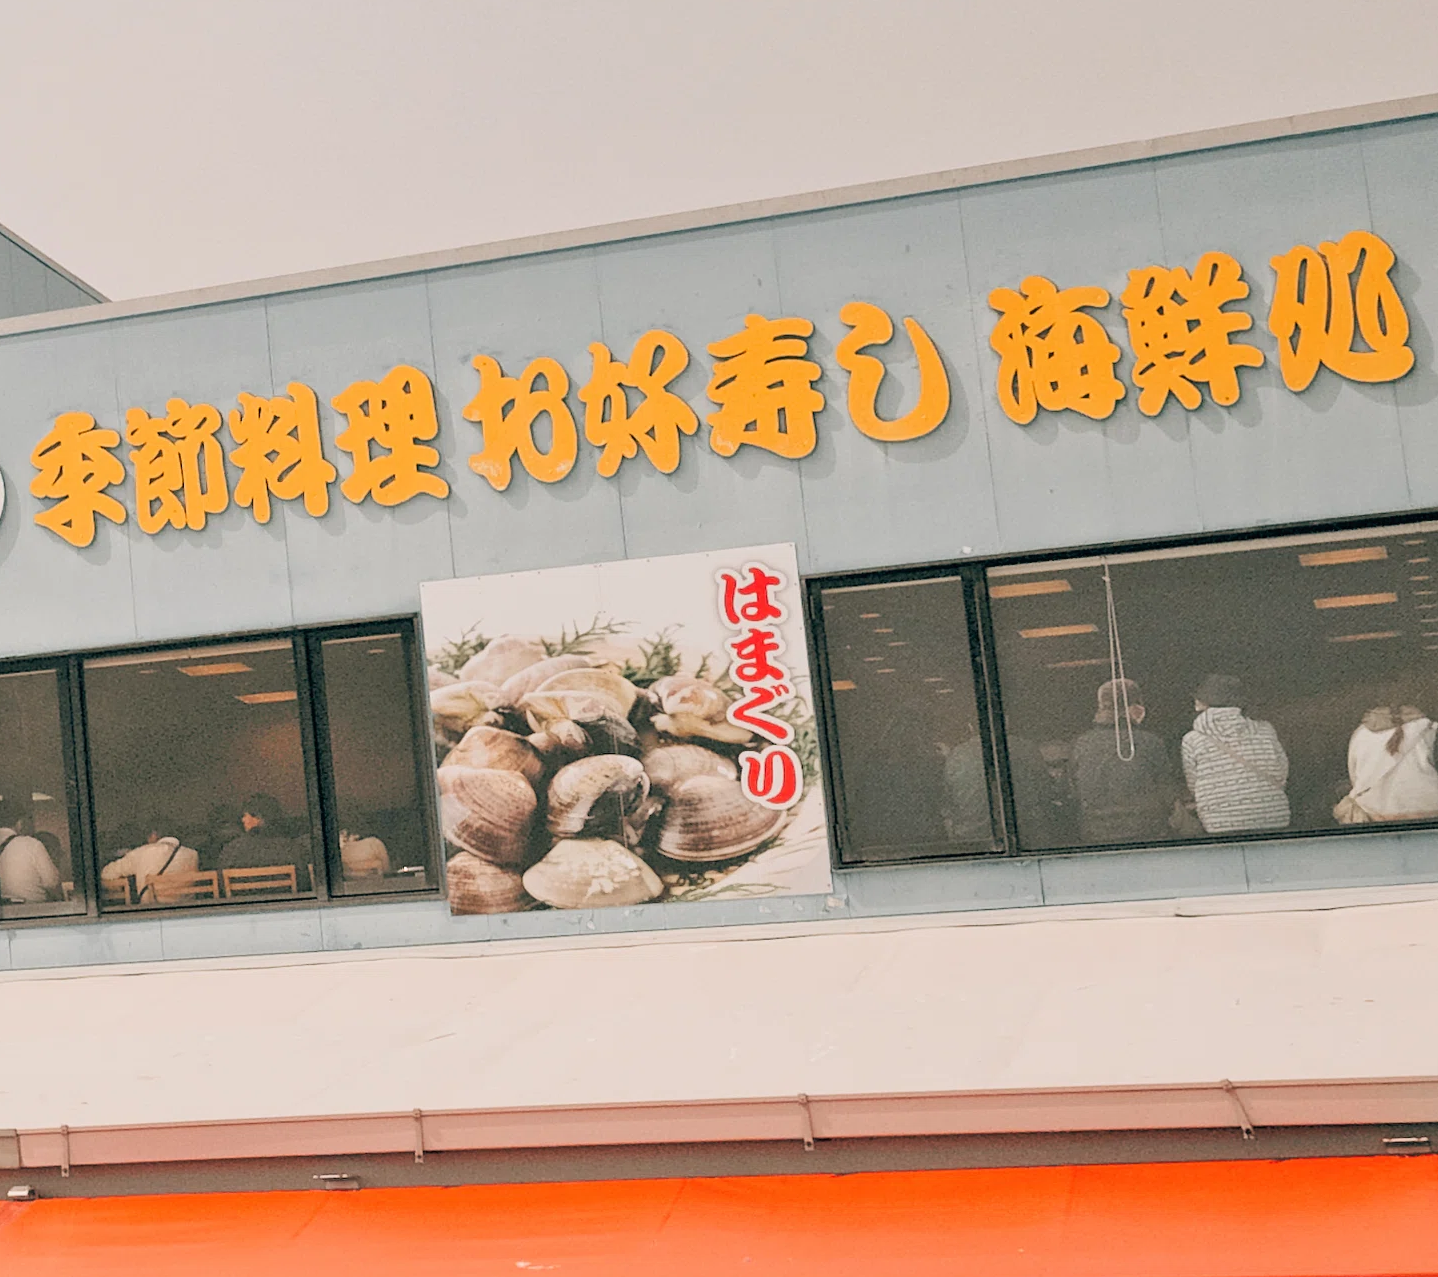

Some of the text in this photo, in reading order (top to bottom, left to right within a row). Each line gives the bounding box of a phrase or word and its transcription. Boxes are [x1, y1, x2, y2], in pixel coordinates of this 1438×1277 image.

[28, 363, 450, 548] 季節料理
[987, 229, 1416, 426] 海鮮処
[717, 562, 803, 811] はまぐり
